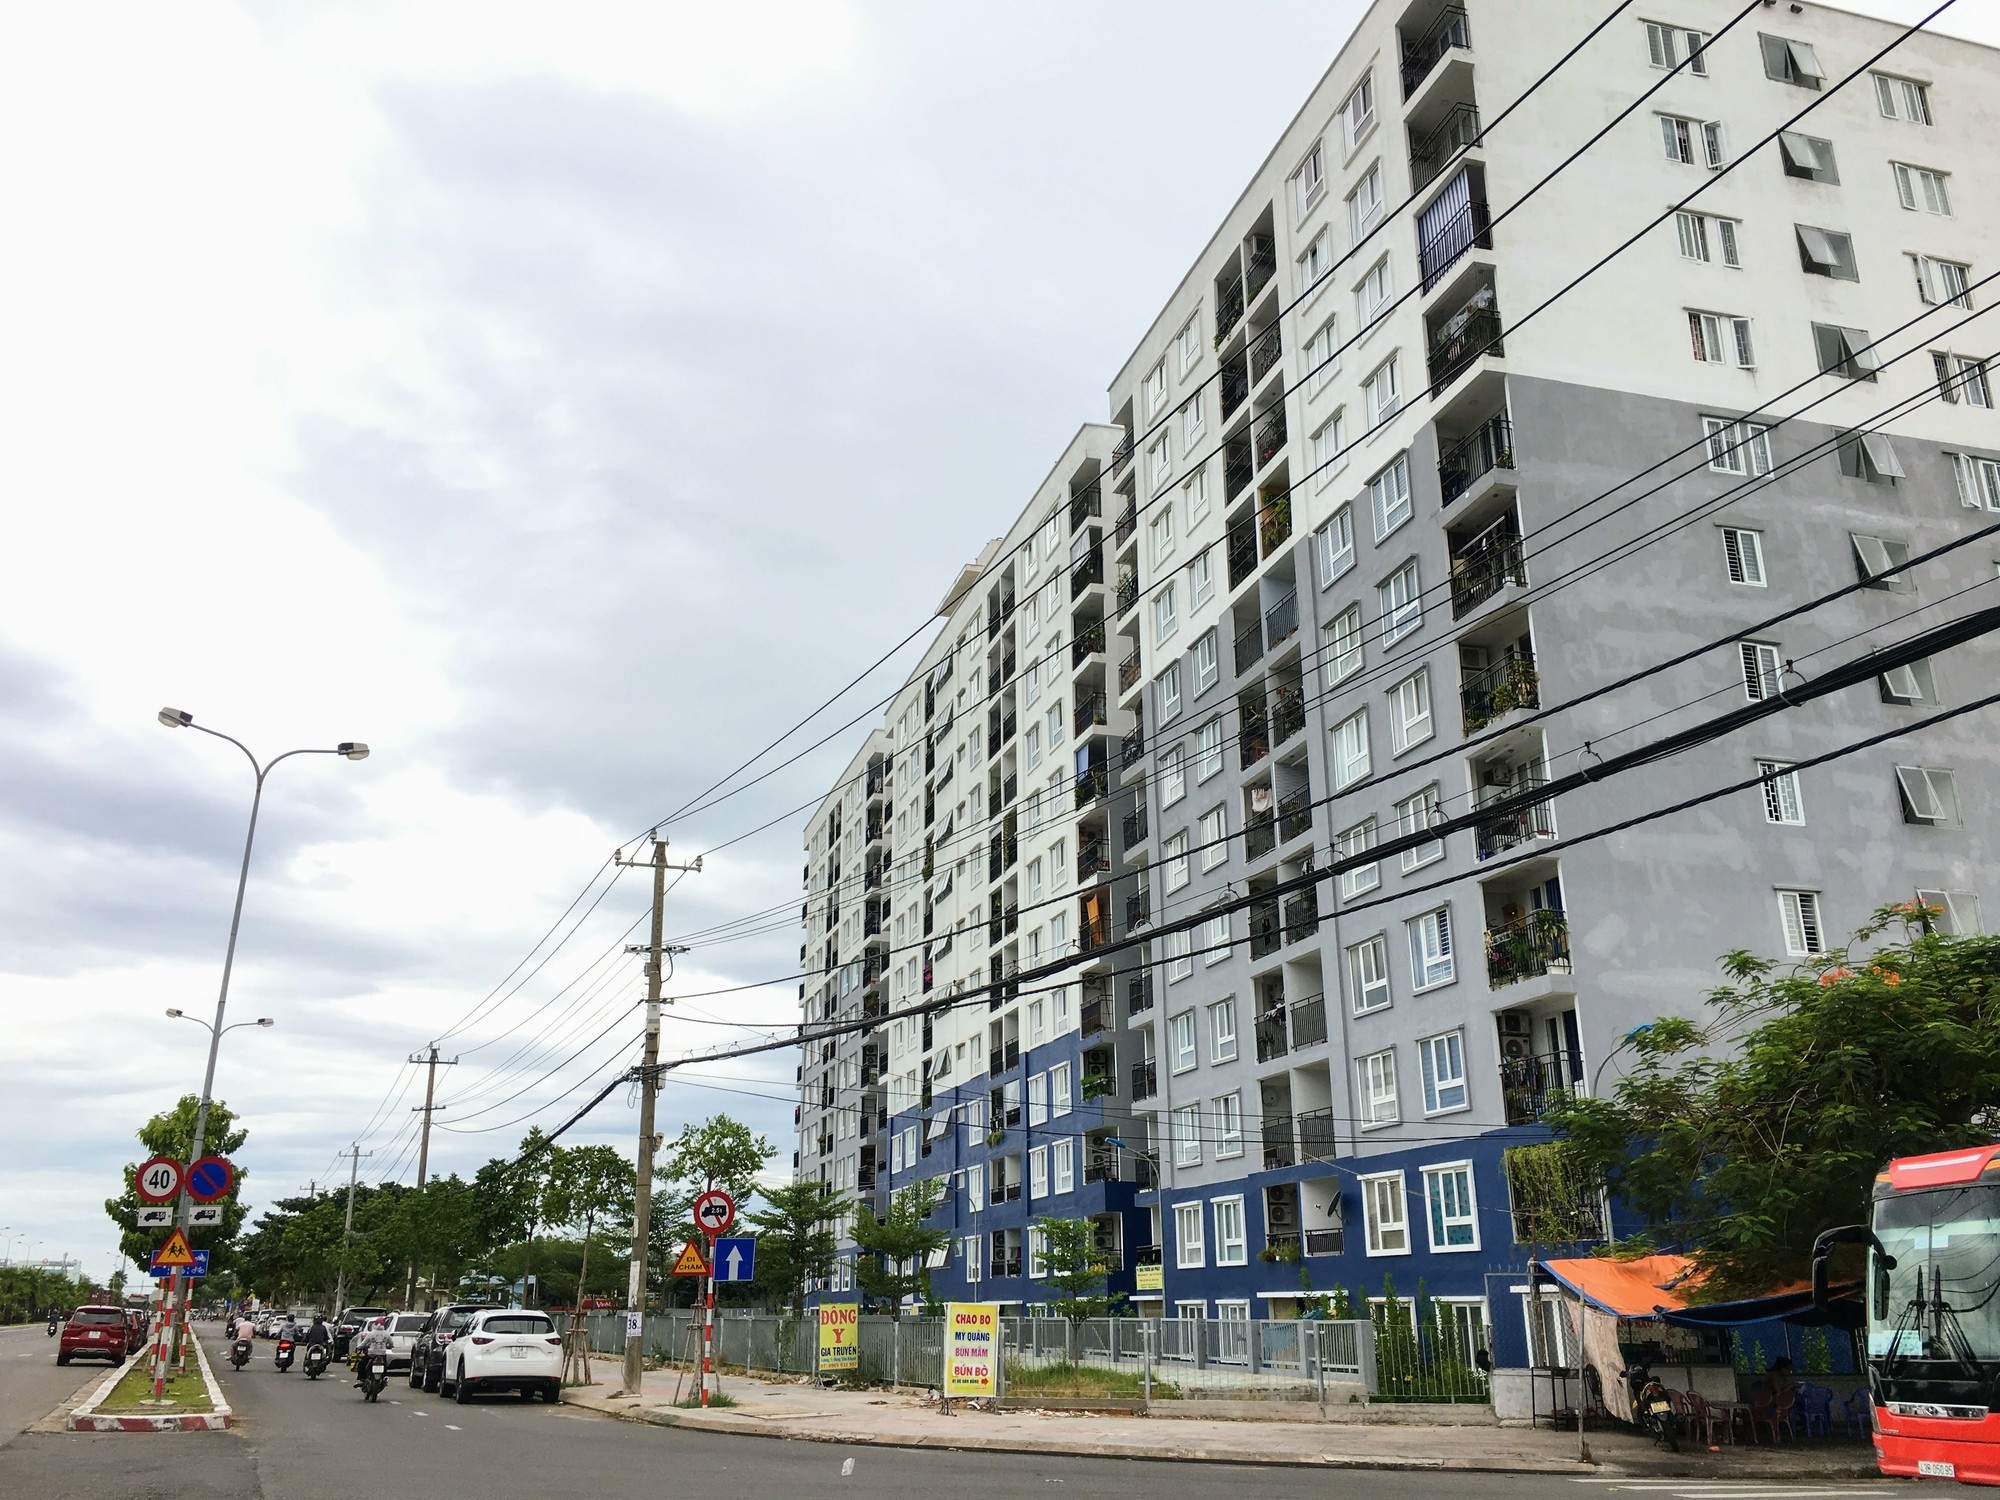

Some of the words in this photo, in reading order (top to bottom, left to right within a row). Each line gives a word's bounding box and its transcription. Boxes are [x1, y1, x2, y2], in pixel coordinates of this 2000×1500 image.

[149, 1169, 170, 1189] 40
[821, 1305, 857, 1325] ĐÔNG
[832, 1328, 846, 1344] Y
[821, 1347, 831, 1356] GIA
[954, 1363, 973, 1376] BÚN
[975, 1364, 988, 1376] BÒ
